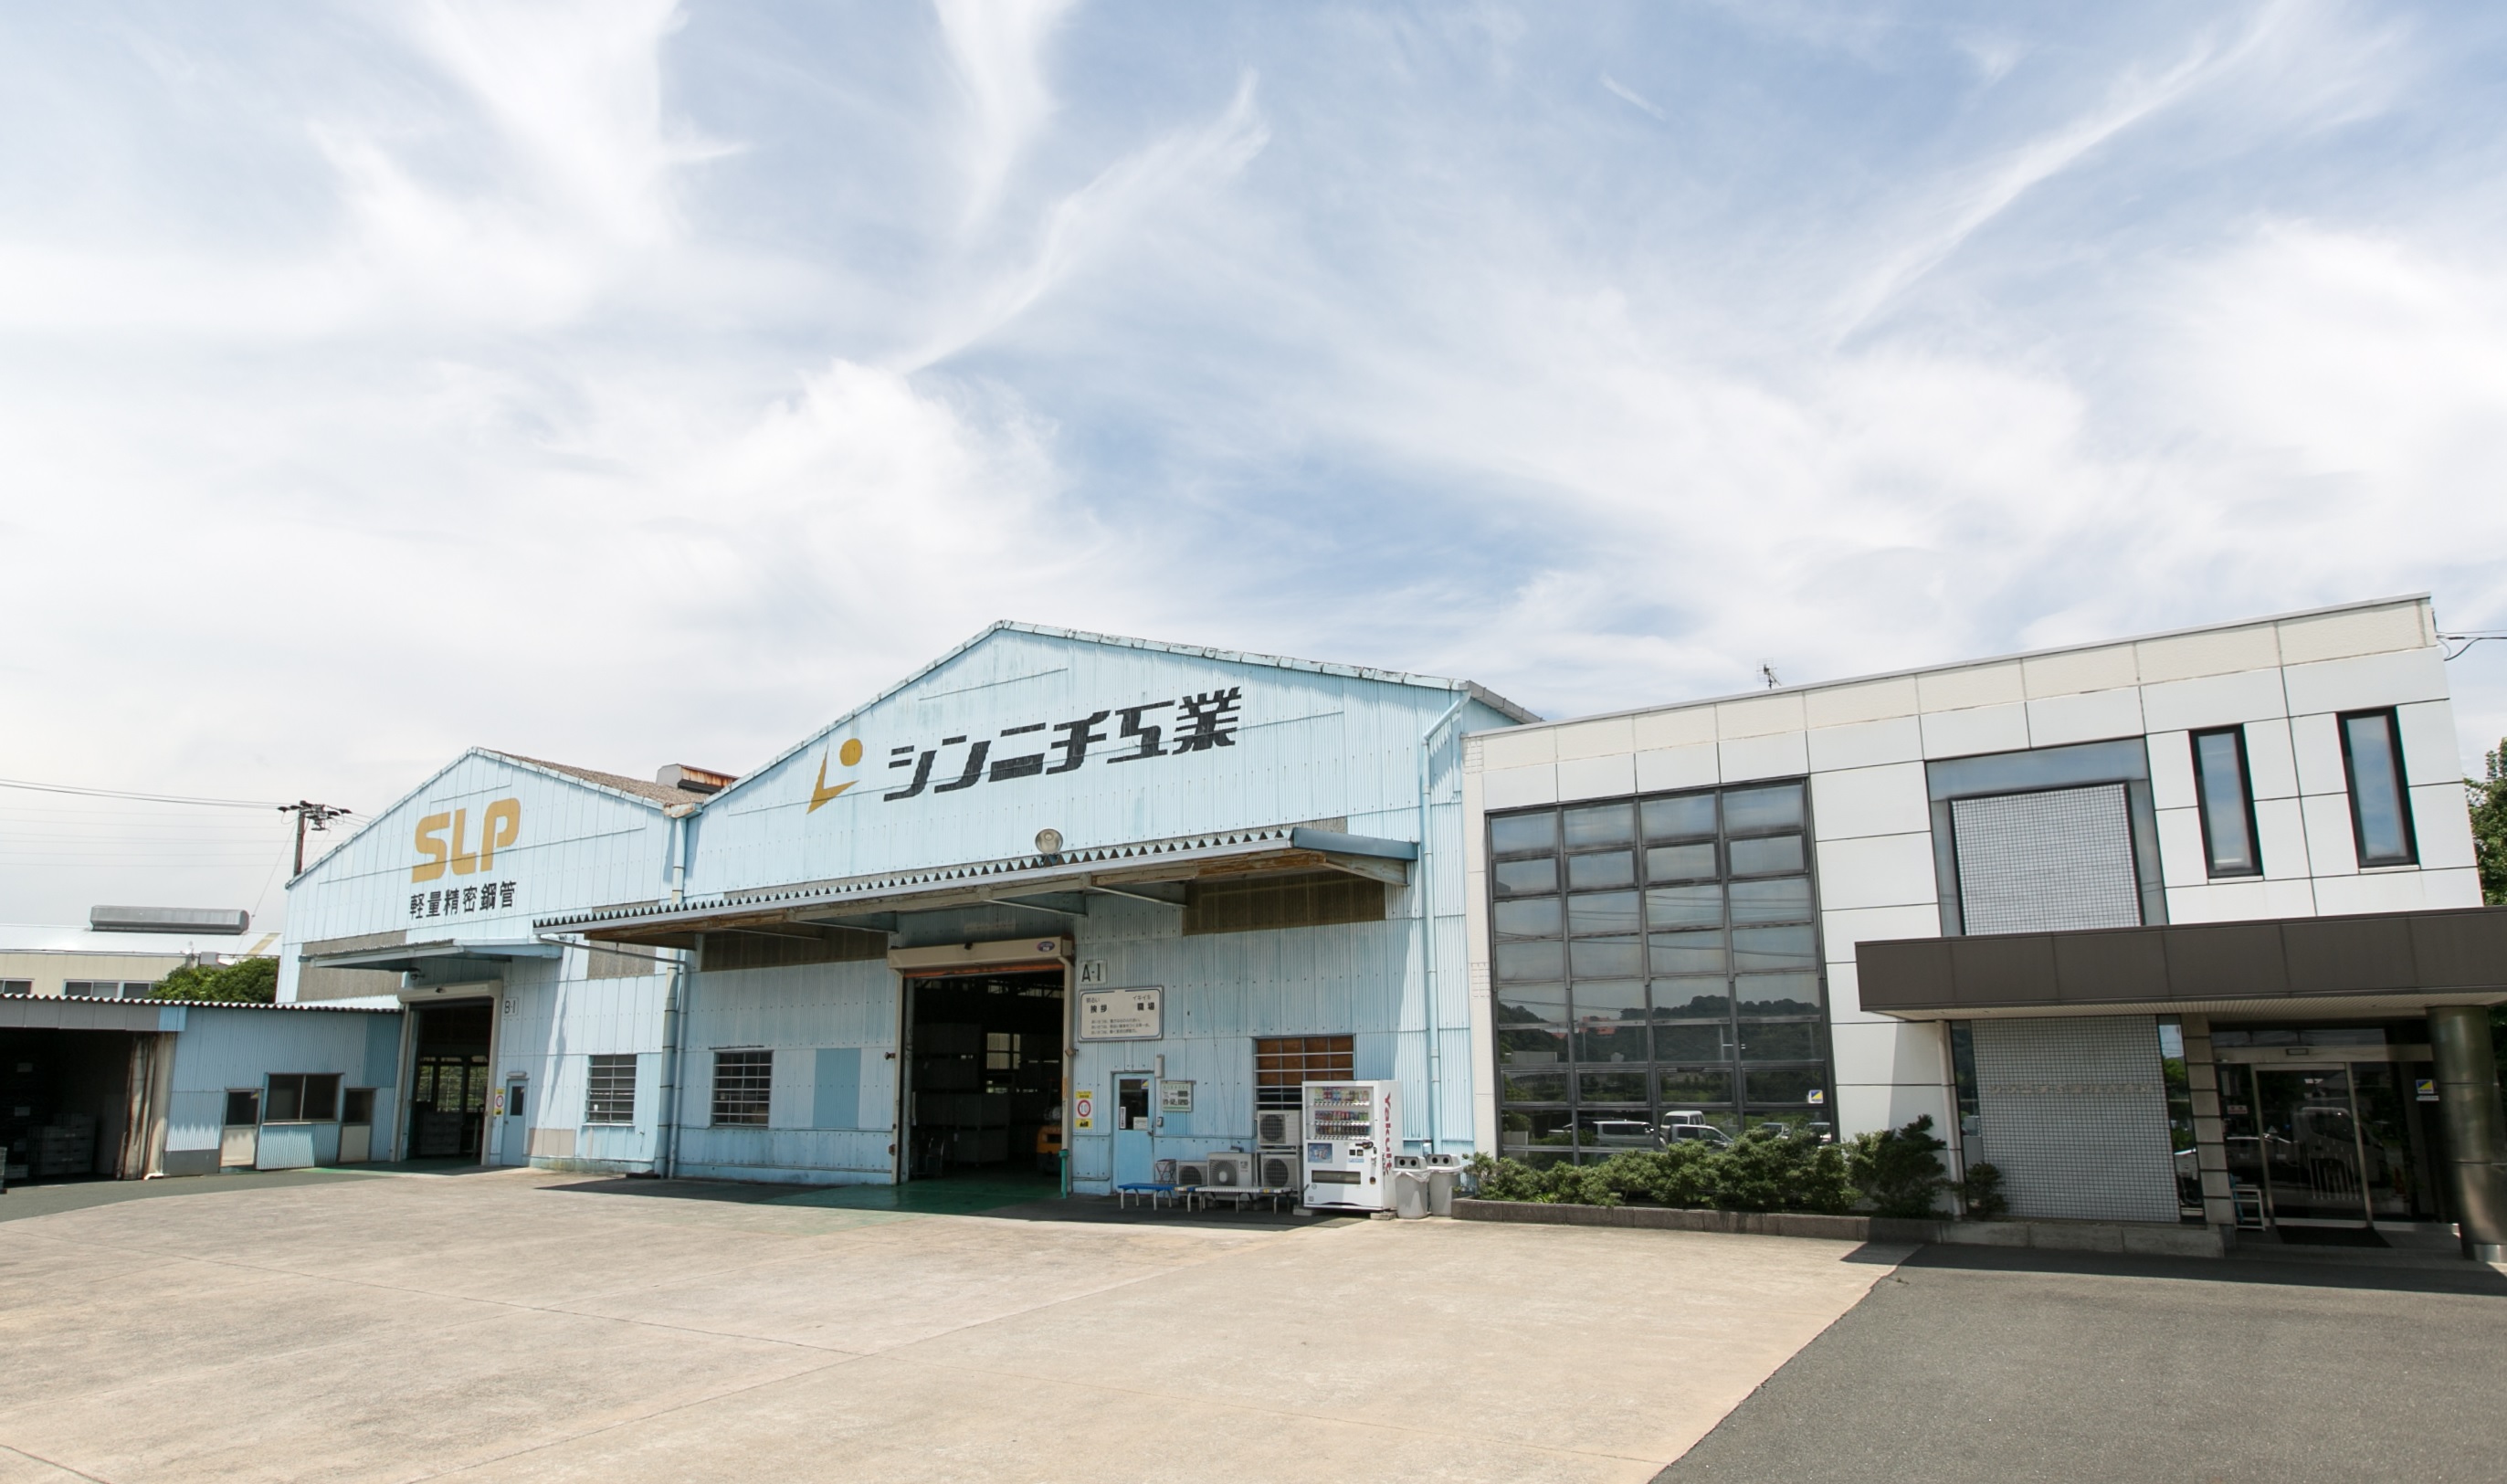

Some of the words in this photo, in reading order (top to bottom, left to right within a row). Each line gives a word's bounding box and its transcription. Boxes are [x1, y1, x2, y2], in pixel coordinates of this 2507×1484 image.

[883, 686, 1242, 802] シンニチ工業
[412, 798, 521, 883] SLP
[410, 881, 517, 920] 軽量精密鋼管
